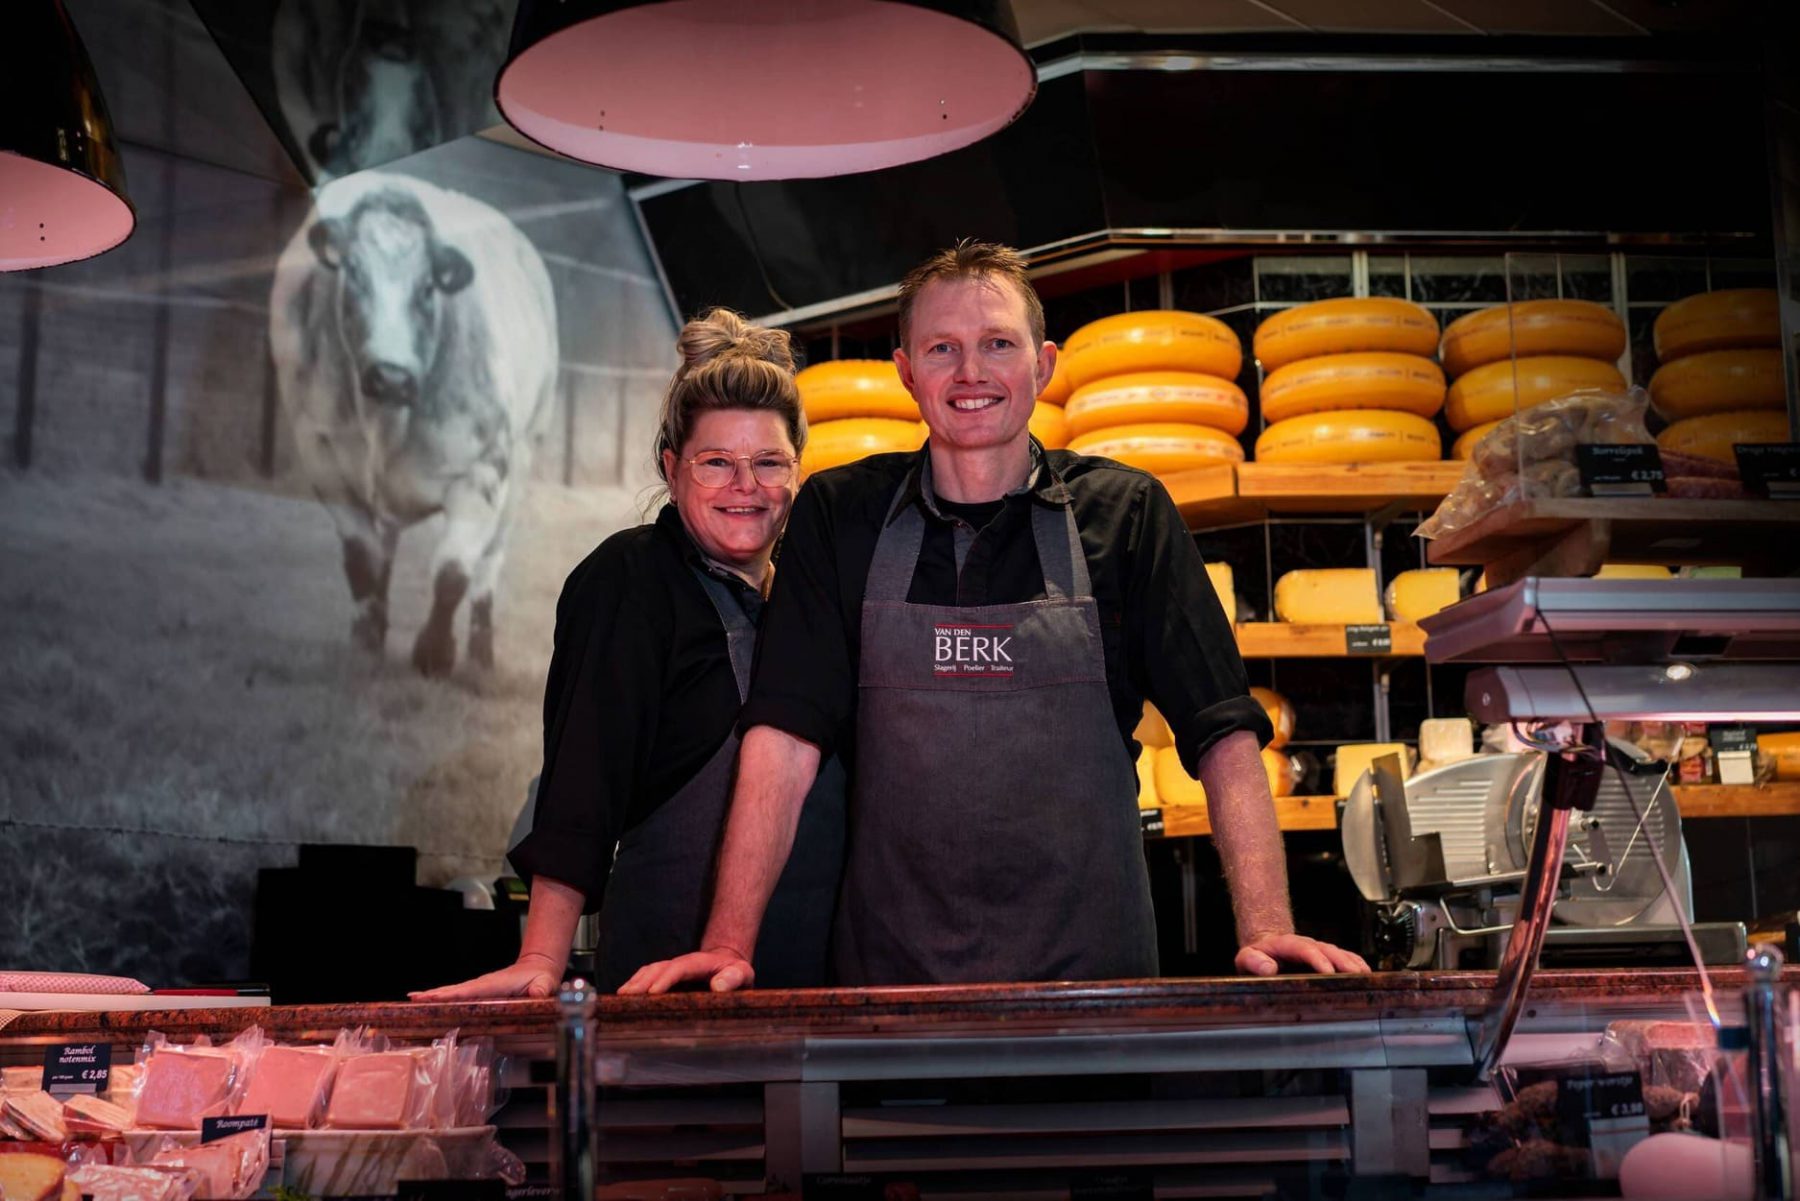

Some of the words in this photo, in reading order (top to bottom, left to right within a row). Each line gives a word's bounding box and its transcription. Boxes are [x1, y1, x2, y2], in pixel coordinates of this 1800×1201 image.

[934, 628, 952, 636] VAN
[954, 628, 972, 636] DEN
[935, 636, 1013, 662] BERK
[64, 1044, 96, 1055] Rambol
[58, 1055, 97, 1064] notenmix
[82, 1069, 88, 1079] €
[89, 1069, 108, 1080] 2,85
